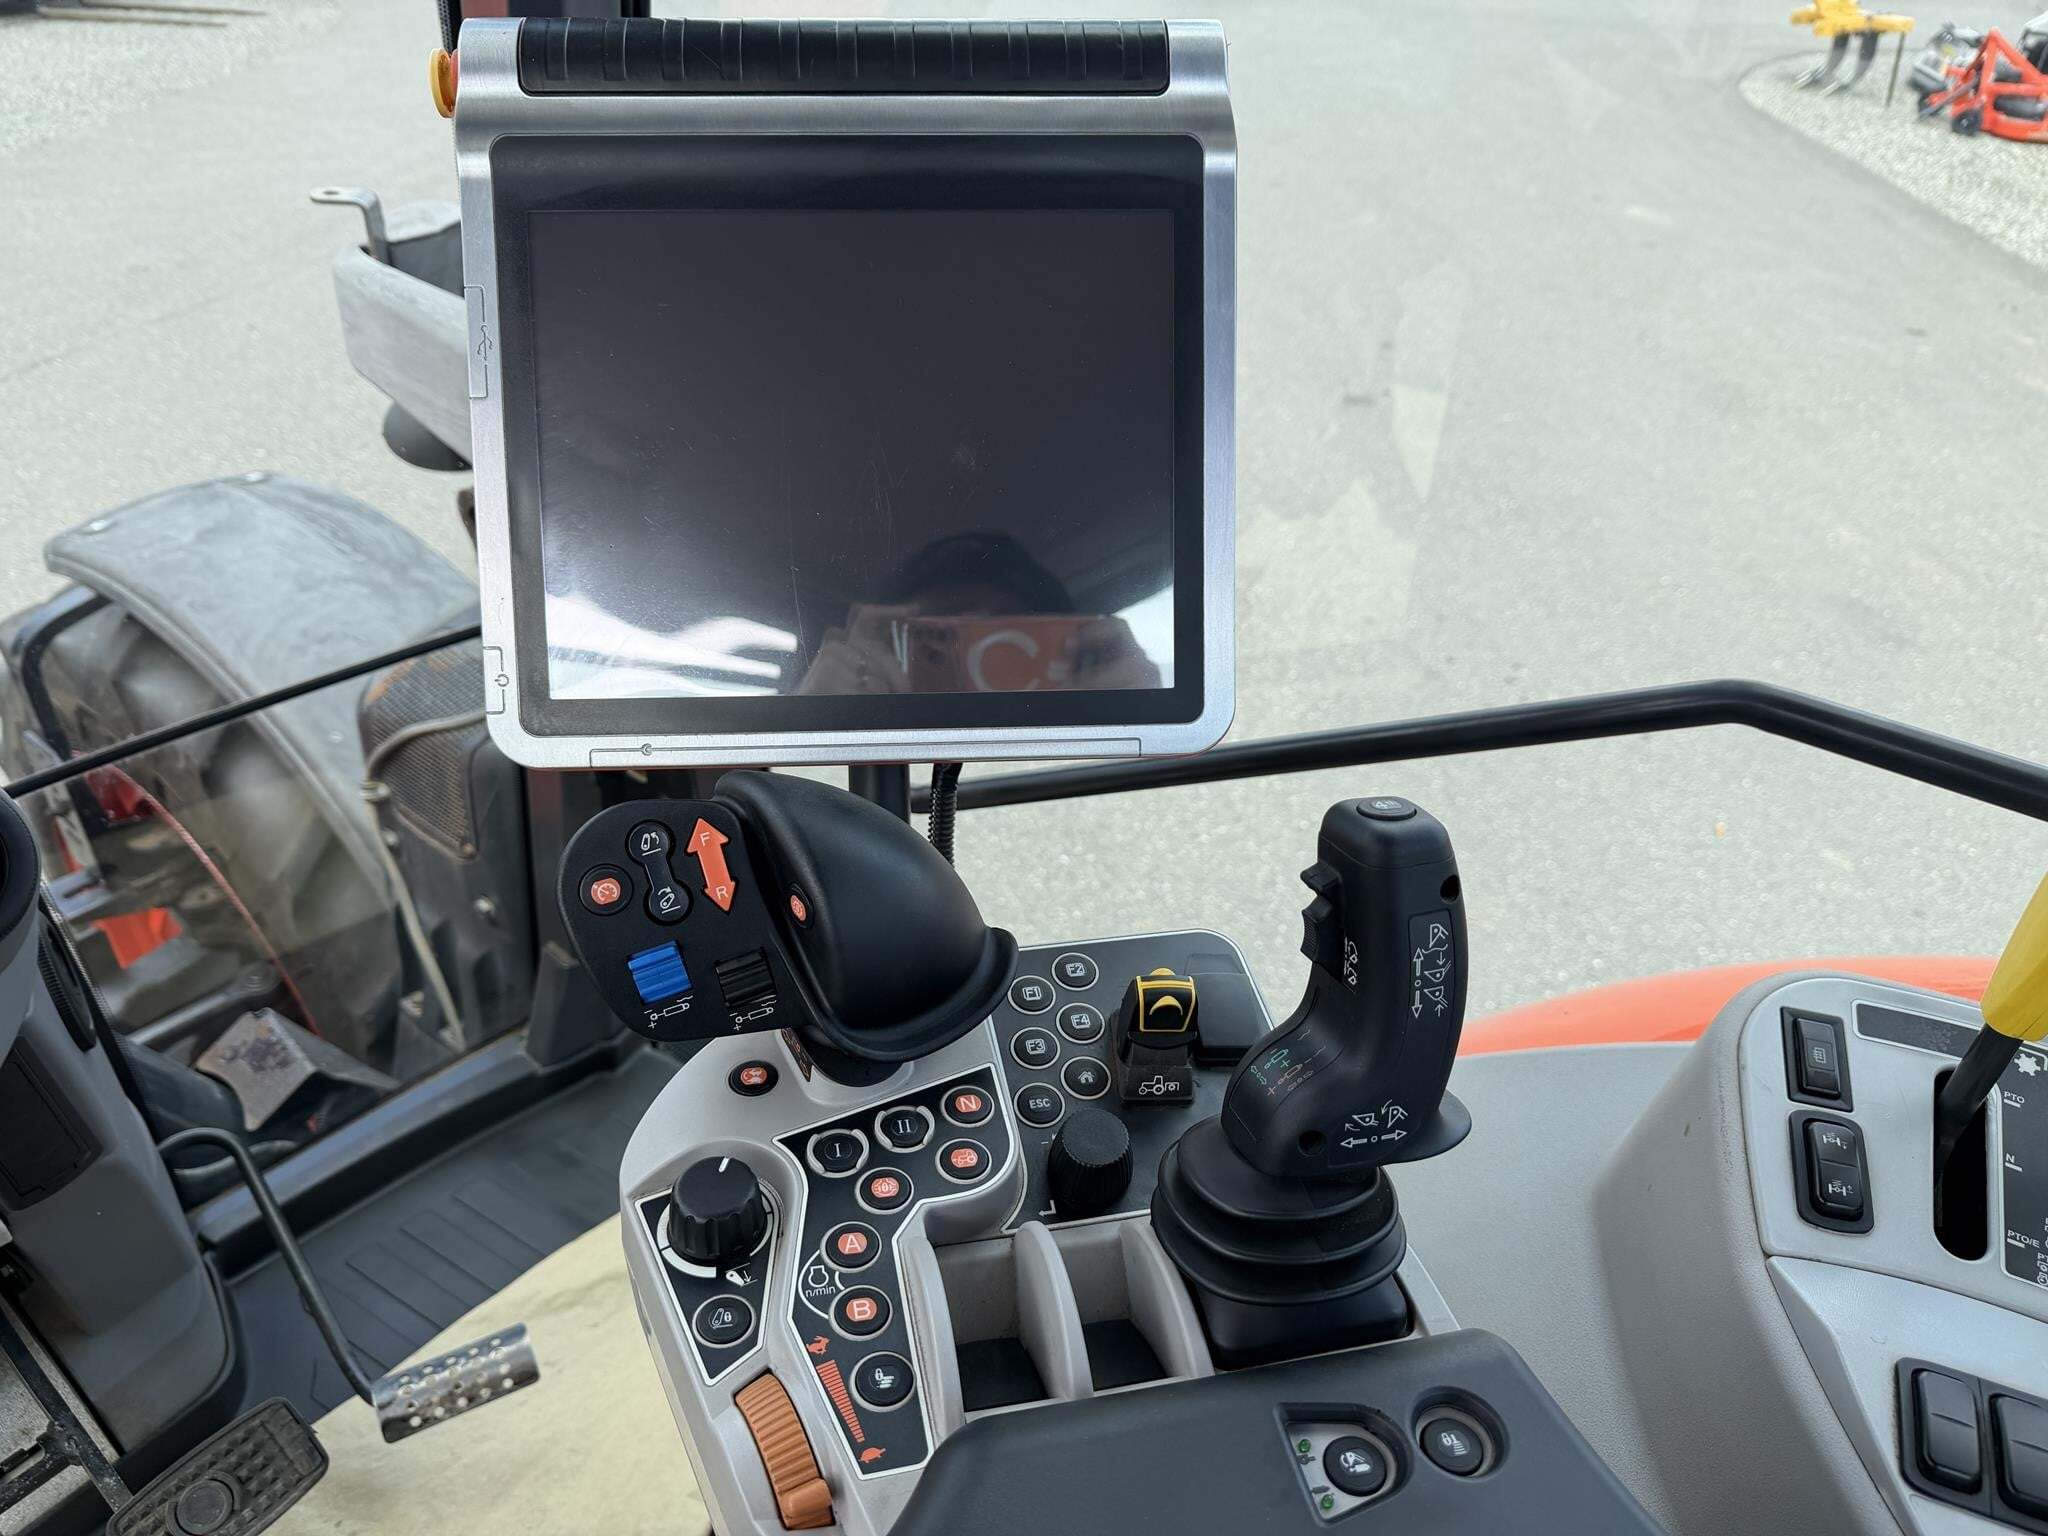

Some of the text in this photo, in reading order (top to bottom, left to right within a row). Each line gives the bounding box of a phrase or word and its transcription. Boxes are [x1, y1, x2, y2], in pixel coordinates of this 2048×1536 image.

[700, 832, 710, 846] F
[716, 886, 728, 900] R
[1068, 964, 1085, 975] F2
[1025, 987, 1040, 999] F1
[1073, 1015, 1089, 1026] F4
[1028, 1041, 1043, 1052] F3
[960, 1095, 976, 1110] N
[1029, 1098, 1051, 1109] ESC
[2004, 1091, 2025, 1104] PTO
[897, 1119, 912, 1134] II
[2006, 1153, 2015, 1164] N
[845, 1233, 861, 1252] A
[2007, 1229, 2041, 1248] PTO/E
[805, 1285, 836, 1298] n/min
[853, 1300, 871, 1320] B
